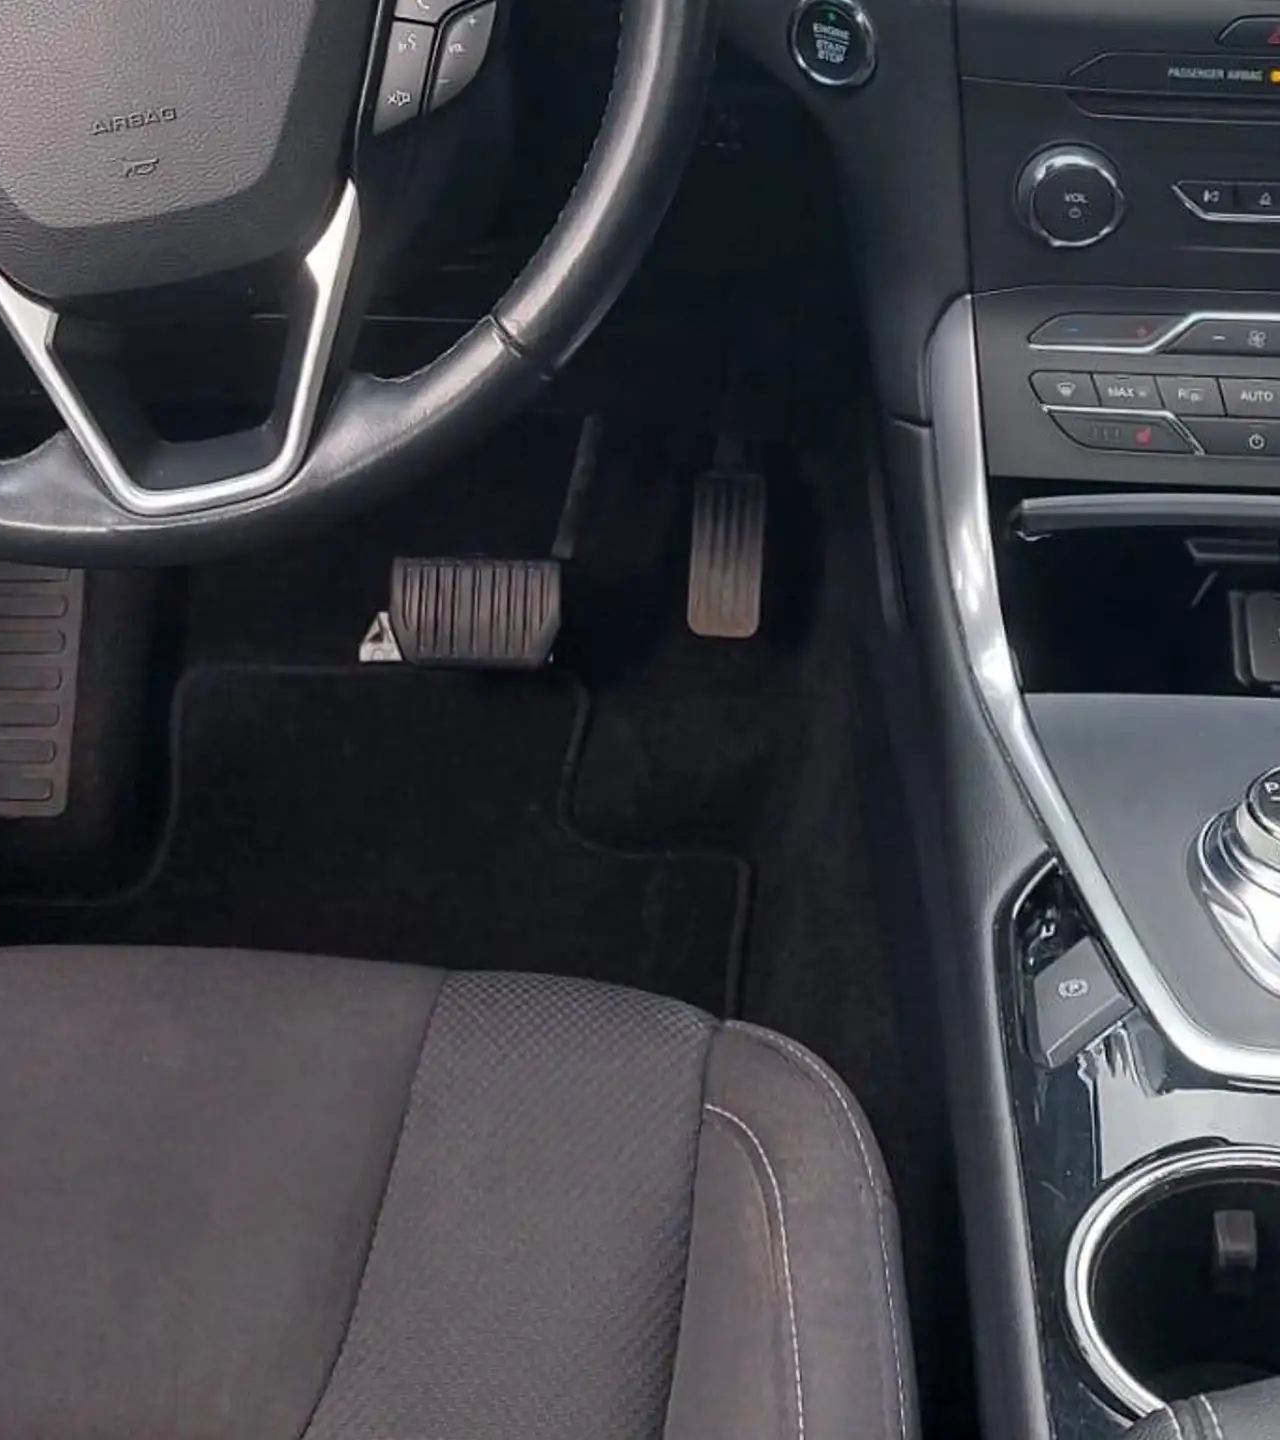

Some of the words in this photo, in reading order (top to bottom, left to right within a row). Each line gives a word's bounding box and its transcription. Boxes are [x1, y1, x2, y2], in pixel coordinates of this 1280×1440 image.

[1167, 66, 1224, 80] PASSENGER
[90, 107, 177, 136] AIRBAG
[1064, 192, 1089, 204] VOL
[1240, 389, 1274, 403] AUTO
[1264, 781, 1280, 794] P
